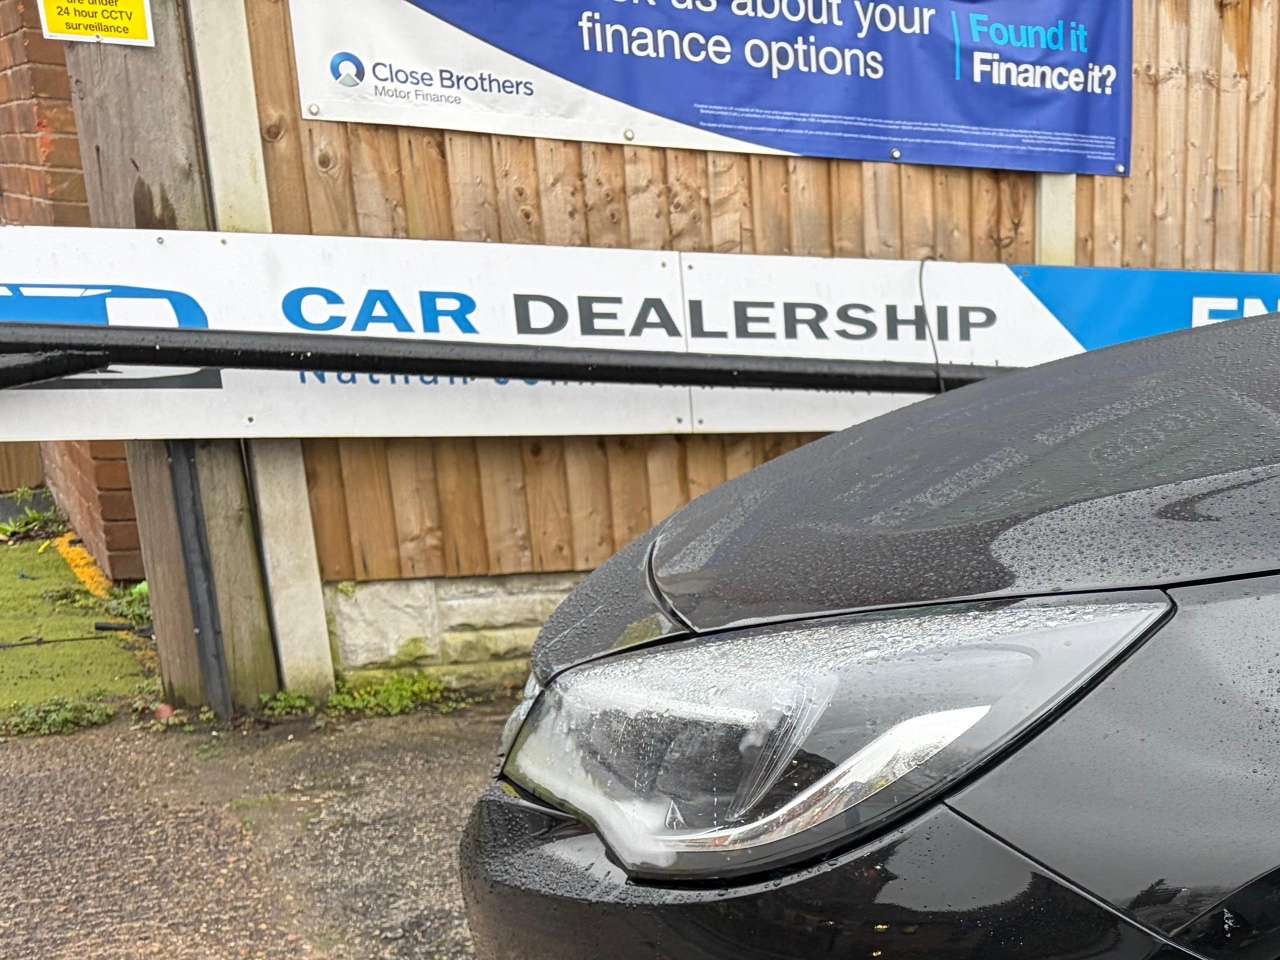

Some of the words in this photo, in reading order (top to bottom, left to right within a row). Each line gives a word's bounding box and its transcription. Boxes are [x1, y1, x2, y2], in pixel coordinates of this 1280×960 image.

[56, 6, 71, 17] 24
[73, 7, 98, 19] hour
[101, 9, 133, 21] CCTV
[65, 22, 129, 34] surveillance
[855, 1, 936, 38] your
[578, 11, 733, 64] finance
[744, 35, 884, 80] options
[969, 12, 1065, 52] Found
[1070, 21, 1089, 54] it
[372, 62, 434, 88] Close
[439, 68, 535, 97] Brothers
[972, 51, 1085, 91] Finance
[1087, 62, 1117, 96] it?
[374, 85, 412, 100] Motor
[414, 89, 462, 105] Finance
[281, 286, 480, 334] CAR
[512, 292, 998, 341] DEALERSHIP
